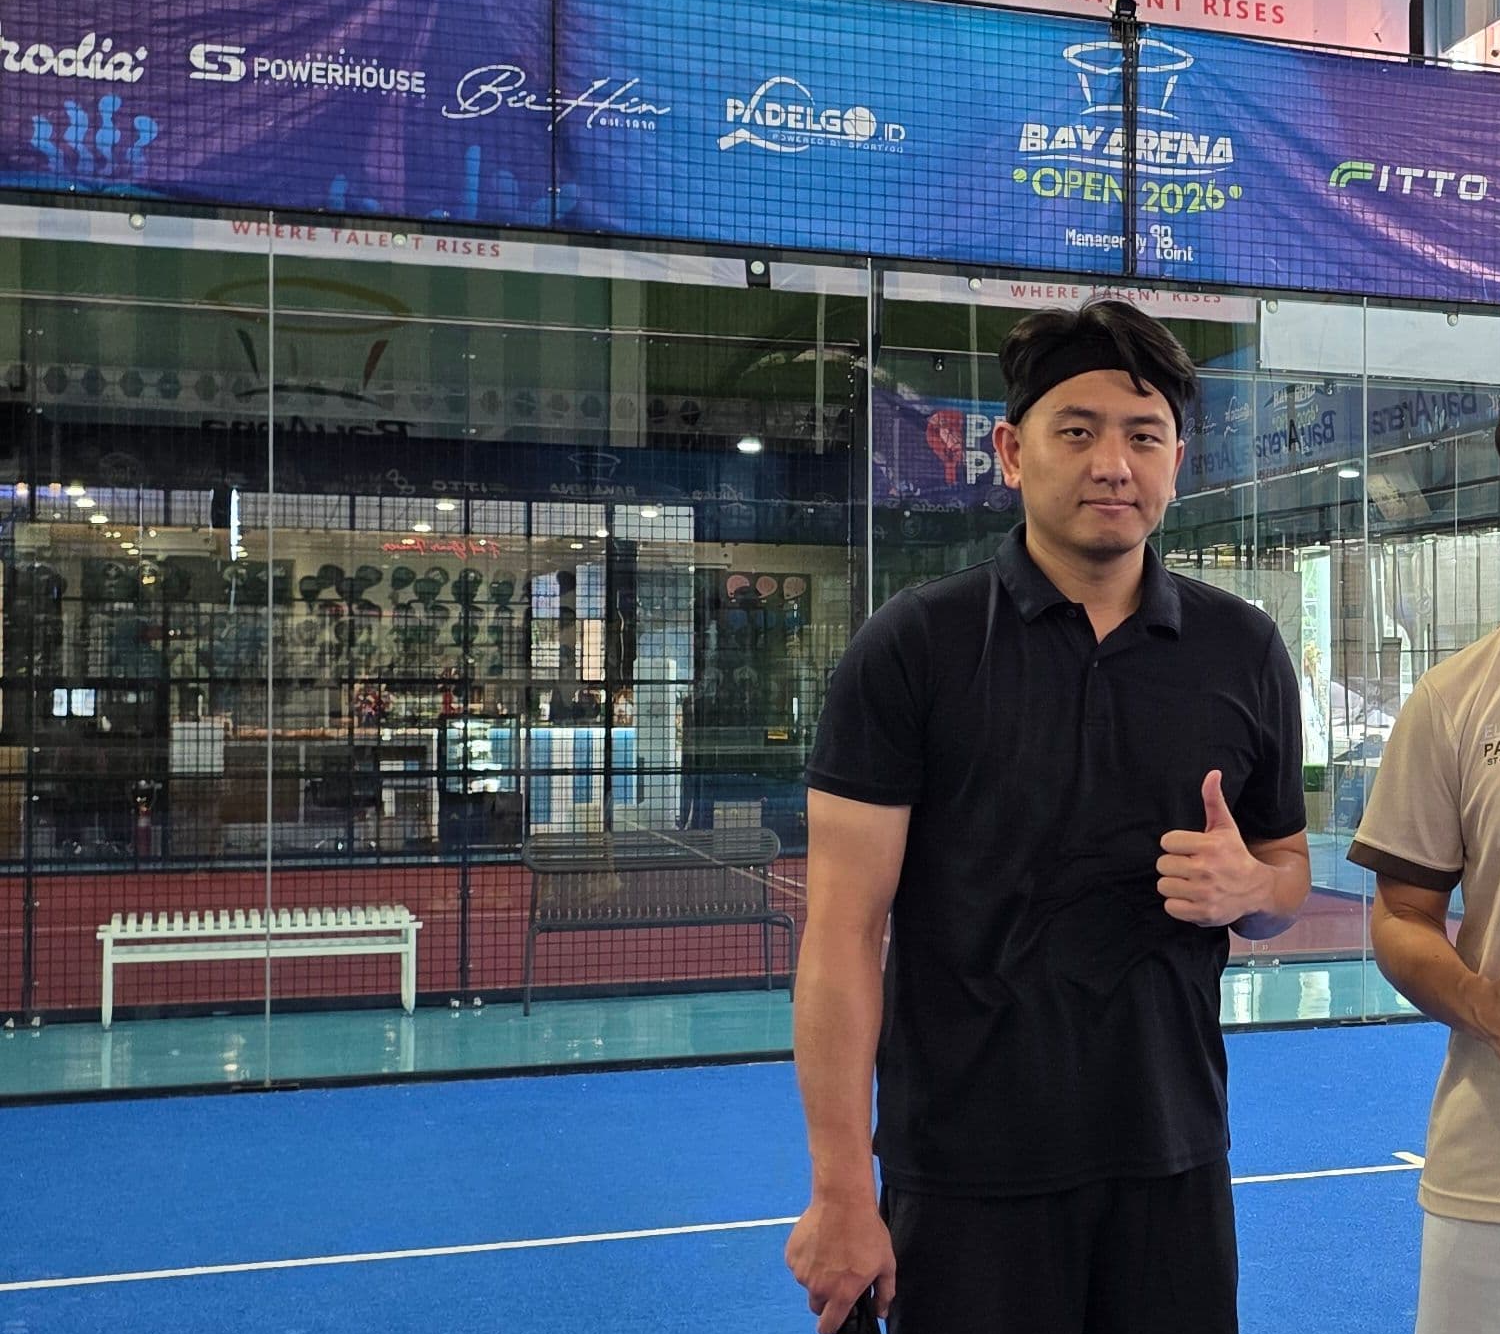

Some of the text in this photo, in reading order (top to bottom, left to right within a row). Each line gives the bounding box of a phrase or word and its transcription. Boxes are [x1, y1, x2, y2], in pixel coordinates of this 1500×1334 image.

[0, 32, 148, 83] rodia
[254, 57, 426, 93] POWERHOUSE
[1032, 167, 1225, 214] OPEN 2026
[232, 221, 500, 257] WHERE TALET RISES
[1010, 285, 1079, 299] WHERE
